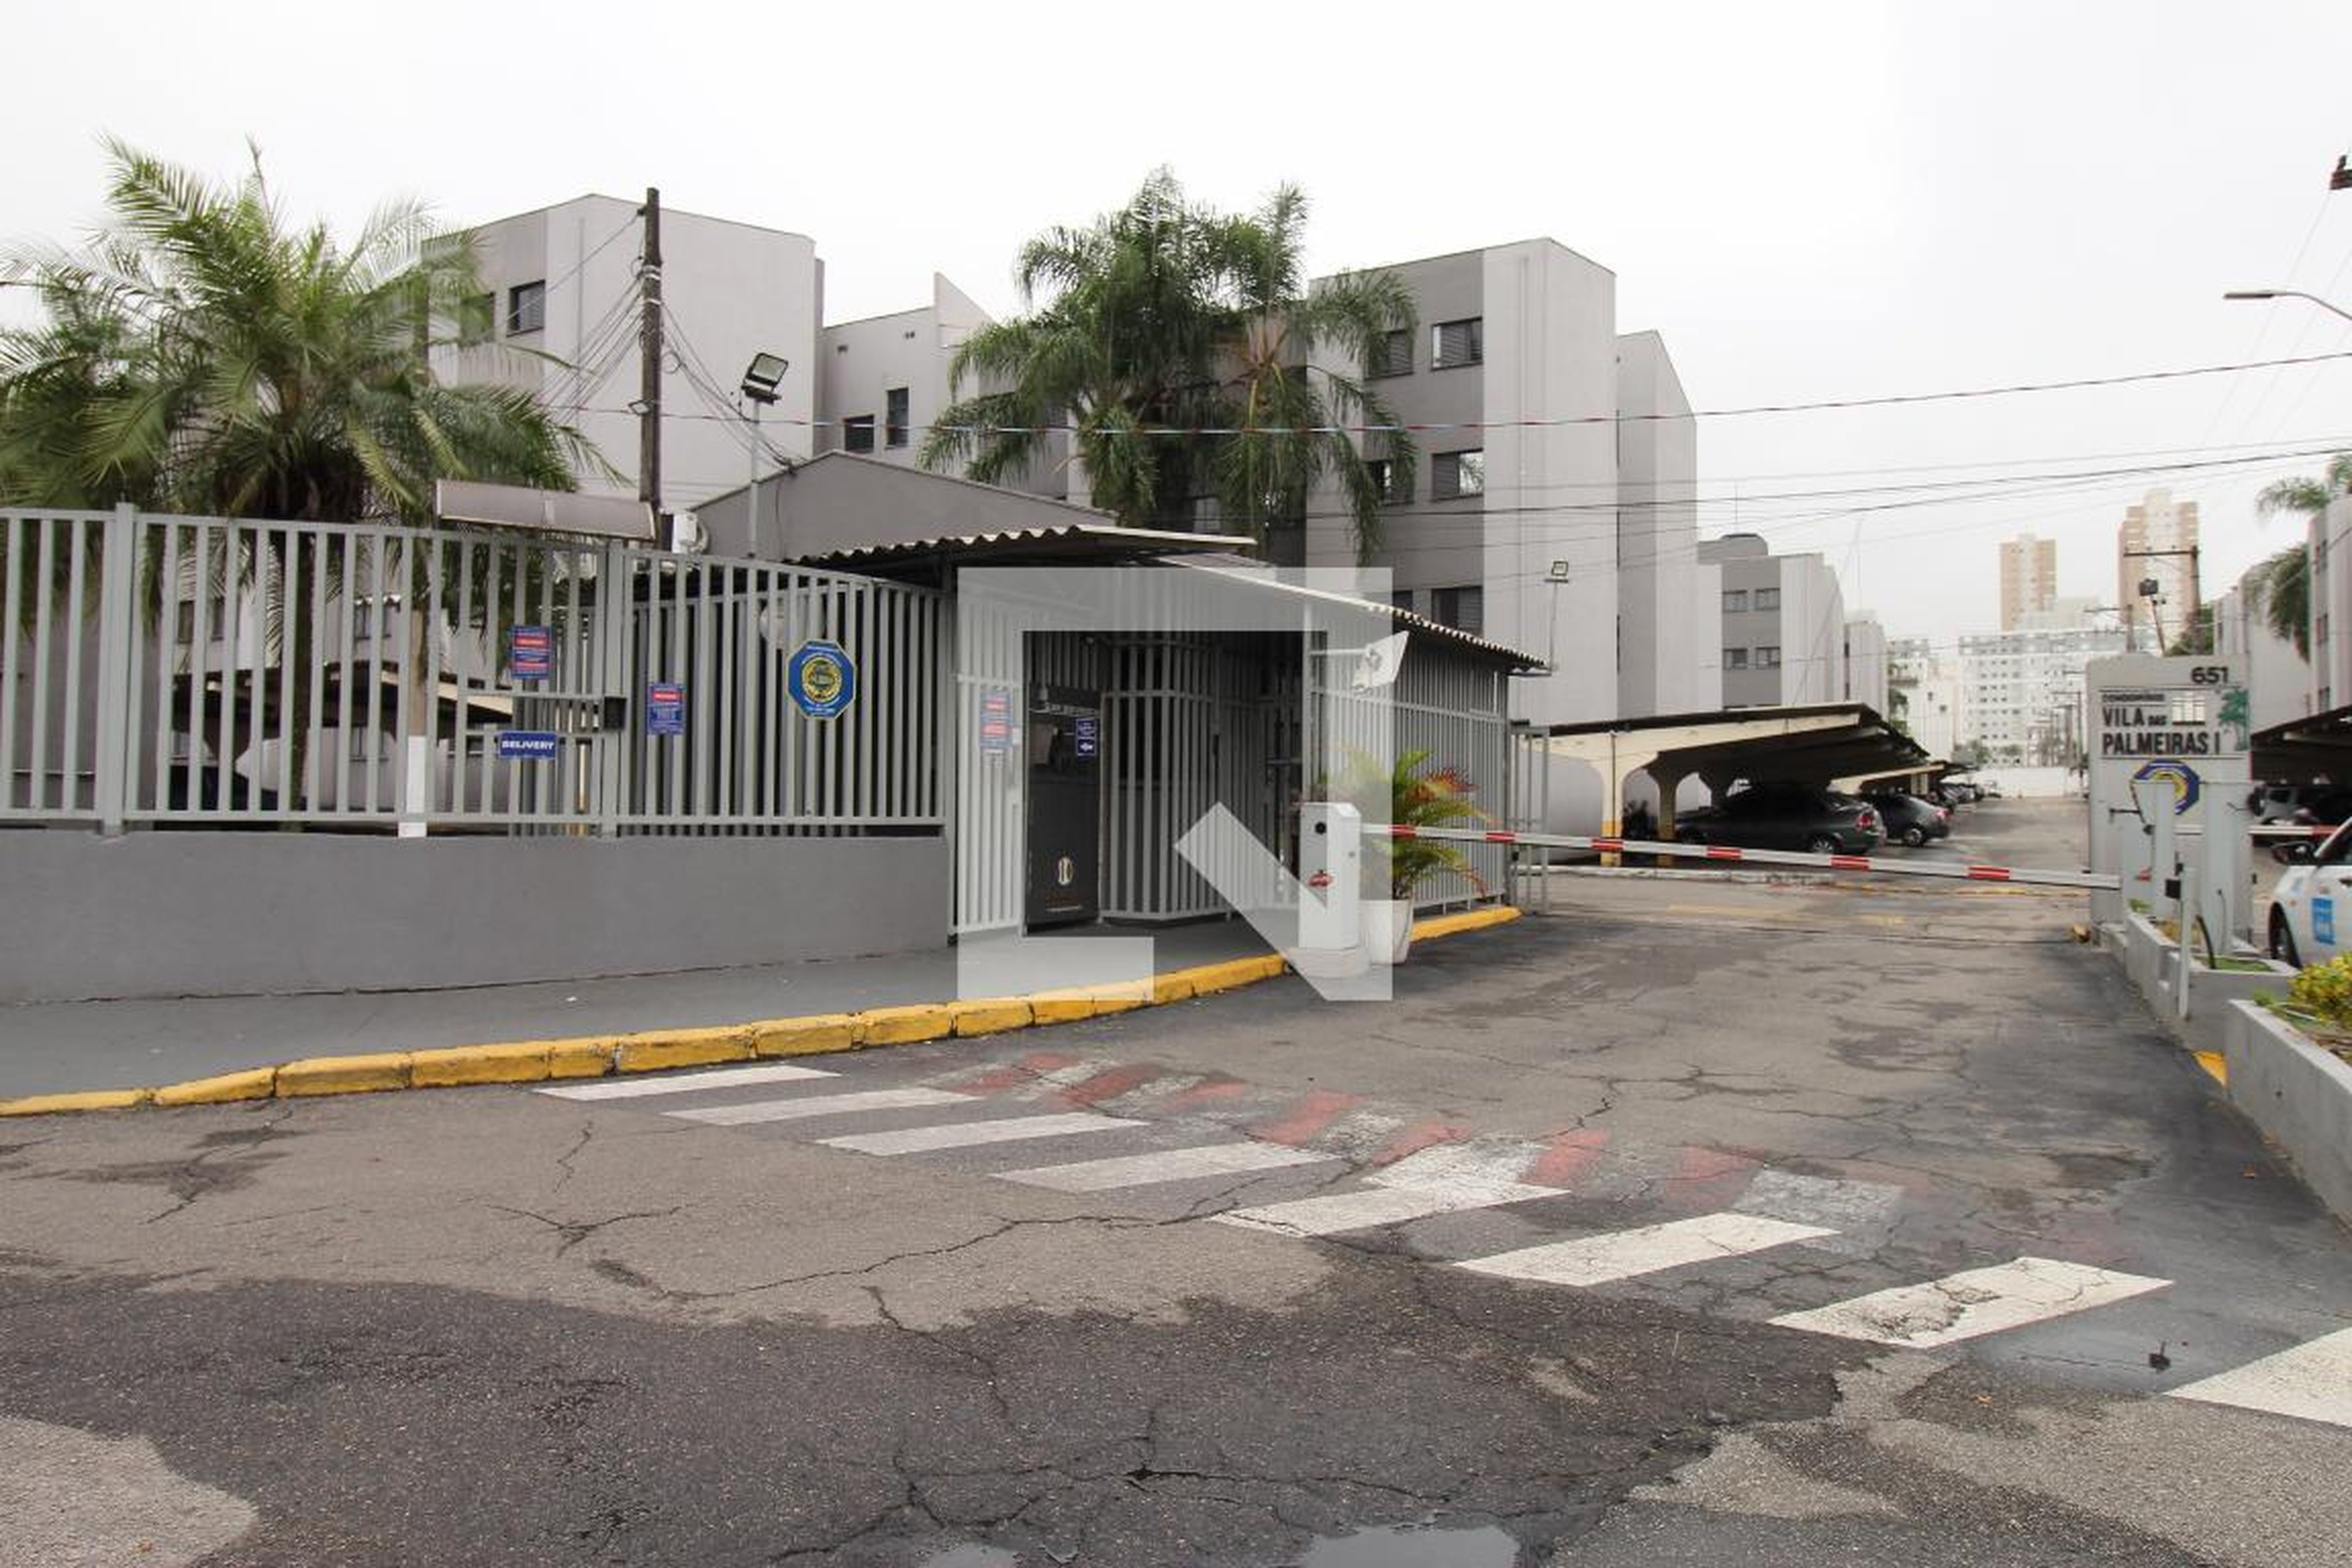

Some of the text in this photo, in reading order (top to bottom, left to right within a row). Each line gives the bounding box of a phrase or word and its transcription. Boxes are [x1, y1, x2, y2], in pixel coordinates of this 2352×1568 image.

[2191, 666, 2228, 684] 651
[2102, 707, 2145, 727] VILA
[502, 741, 554, 750] DELIVERY
[2102, 732, 2209, 755] PALMEIRAS
